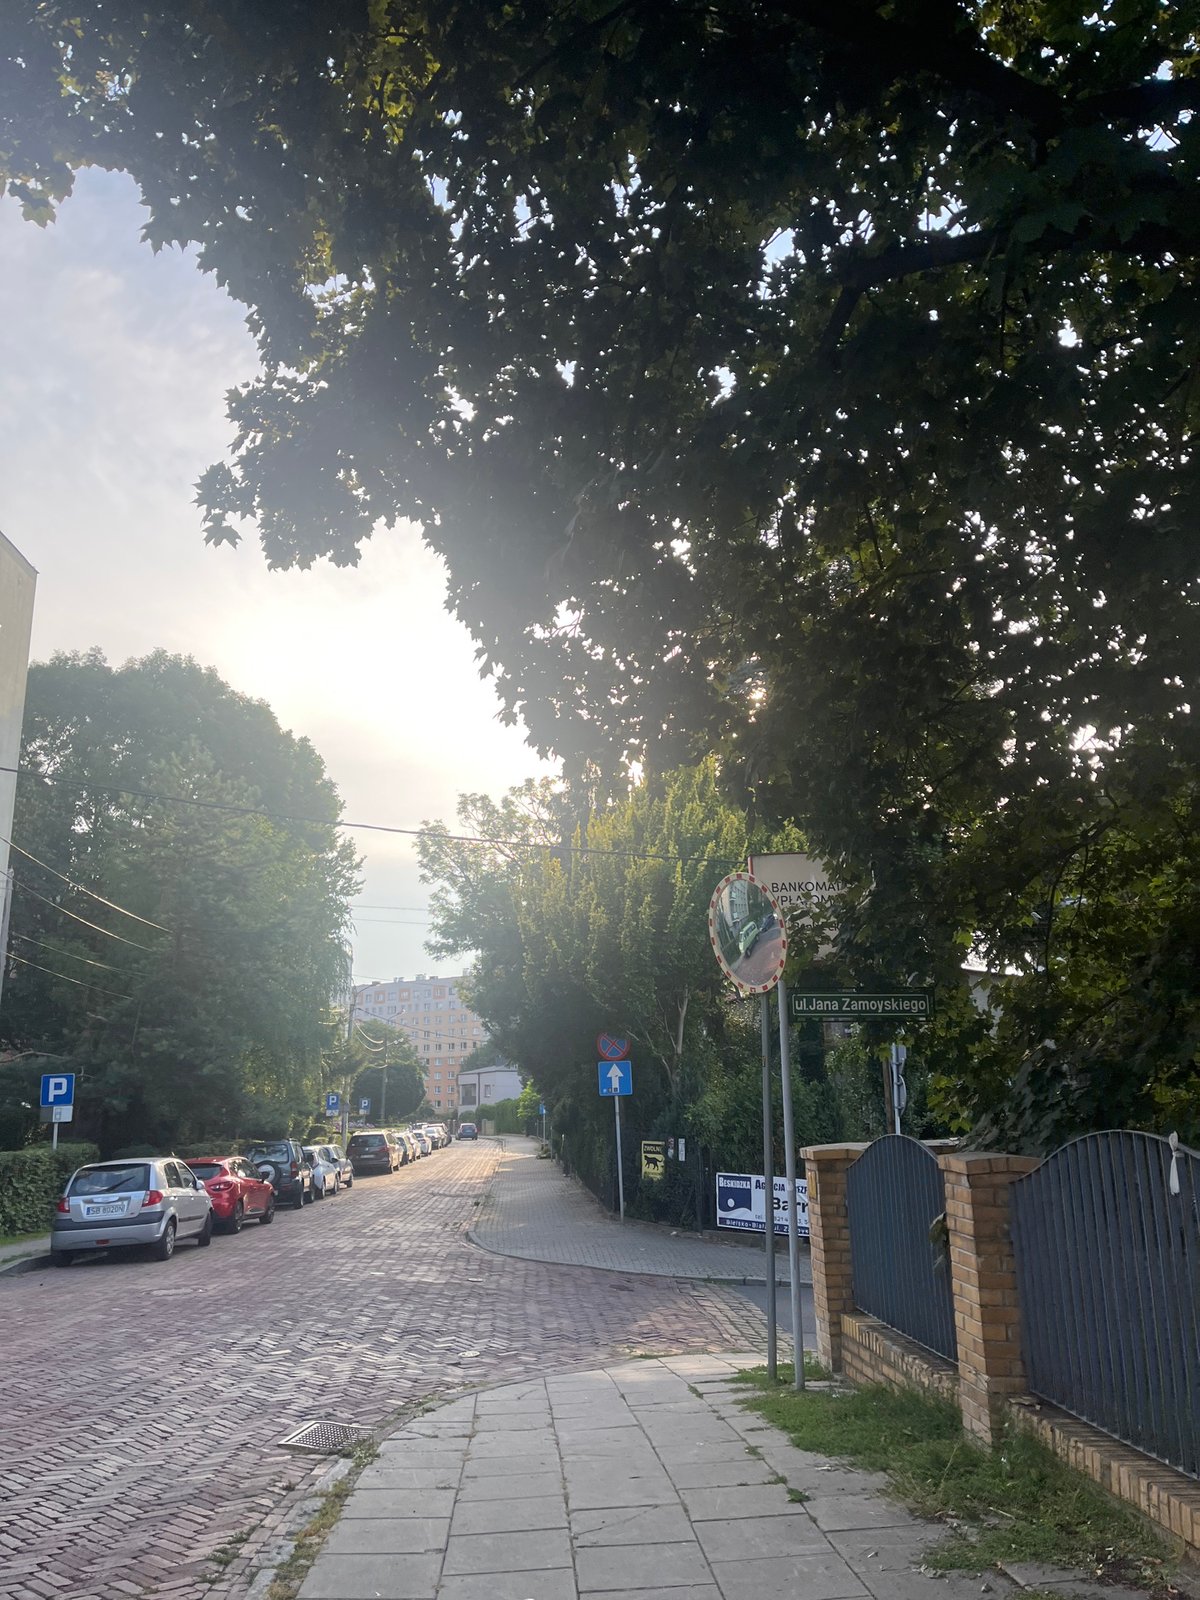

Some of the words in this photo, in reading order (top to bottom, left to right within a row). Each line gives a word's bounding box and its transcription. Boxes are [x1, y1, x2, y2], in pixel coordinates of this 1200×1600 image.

[841, 998, 927, 1013] Zamoyskiego
[49, 1078, 67, 1102] P
[329, 1095, 337, 1106] P
[361, 1099, 369, 1109] P
[755, 1179, 786, 1192] AGCJA
